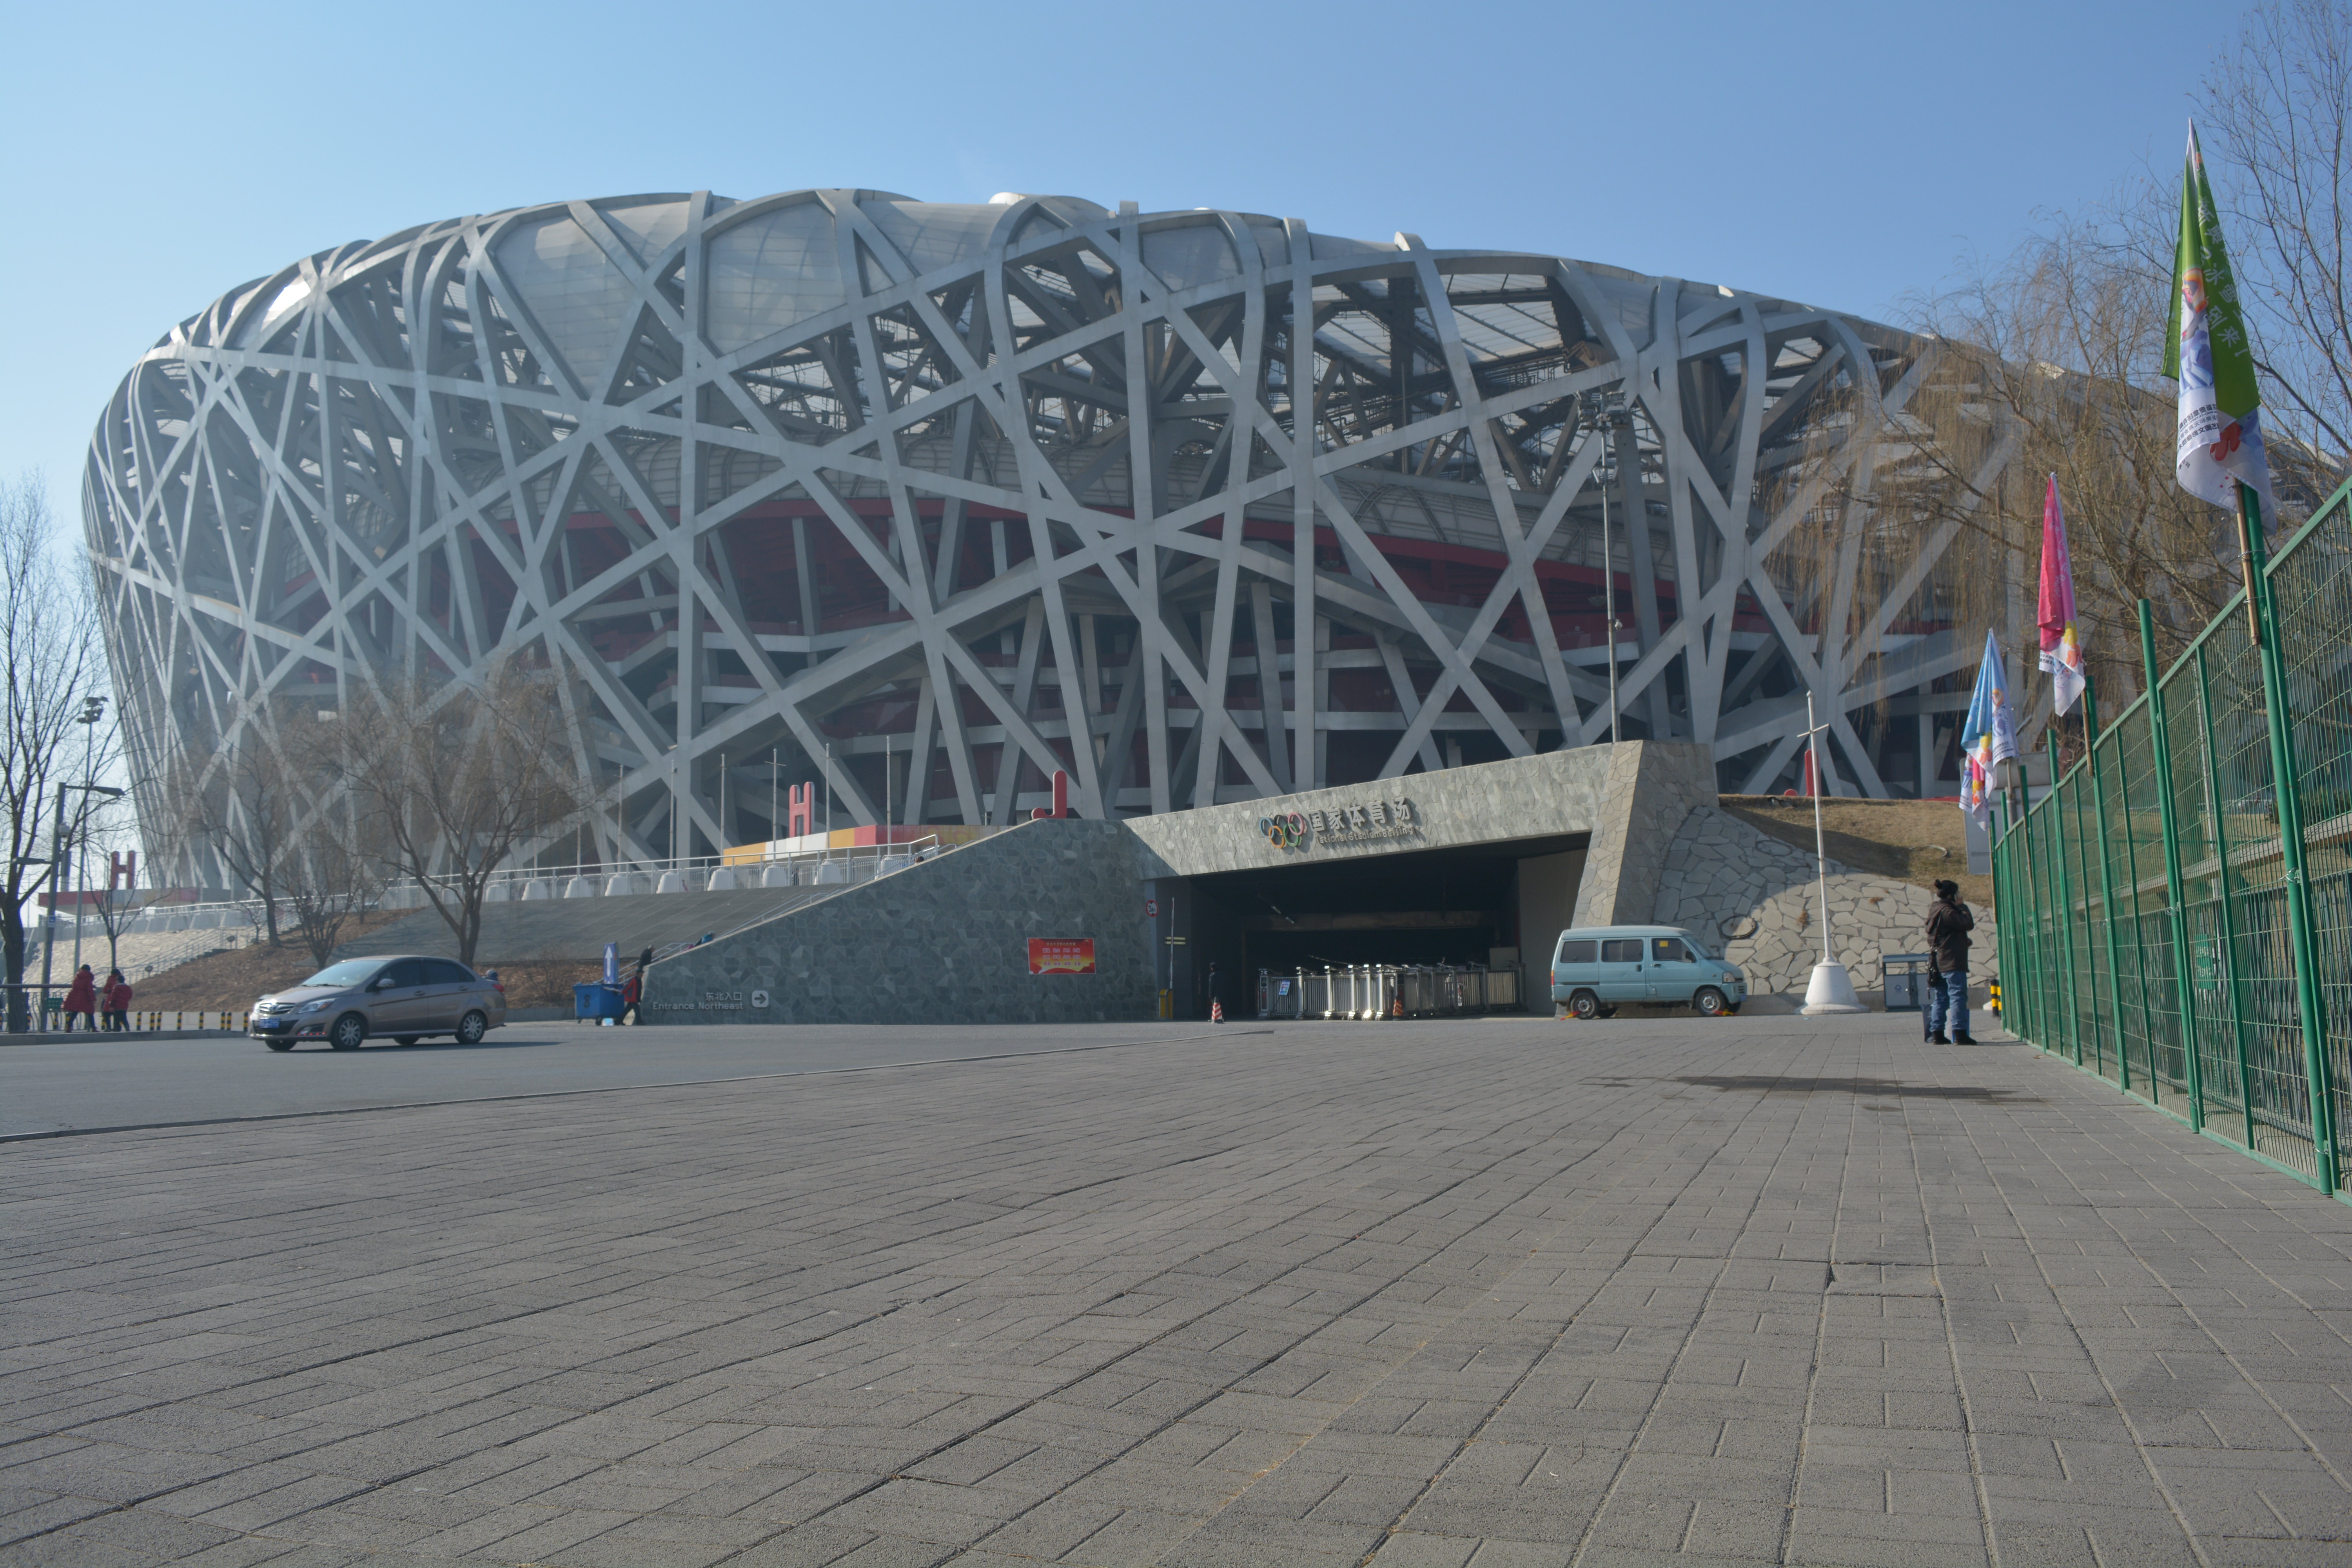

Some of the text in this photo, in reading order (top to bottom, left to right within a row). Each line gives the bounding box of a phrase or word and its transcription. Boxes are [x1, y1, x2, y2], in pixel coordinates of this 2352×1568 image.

[789, 782, 815, 838] H
[1031, 770, 1067, 820] J
[1308, 797, 1411, 831] 国家体育场
[1316, 825, 1414, 844] National Stadium Beijing
[111, 850, 135, 889] H
[706, 992, 742, 1001] 东北入口
